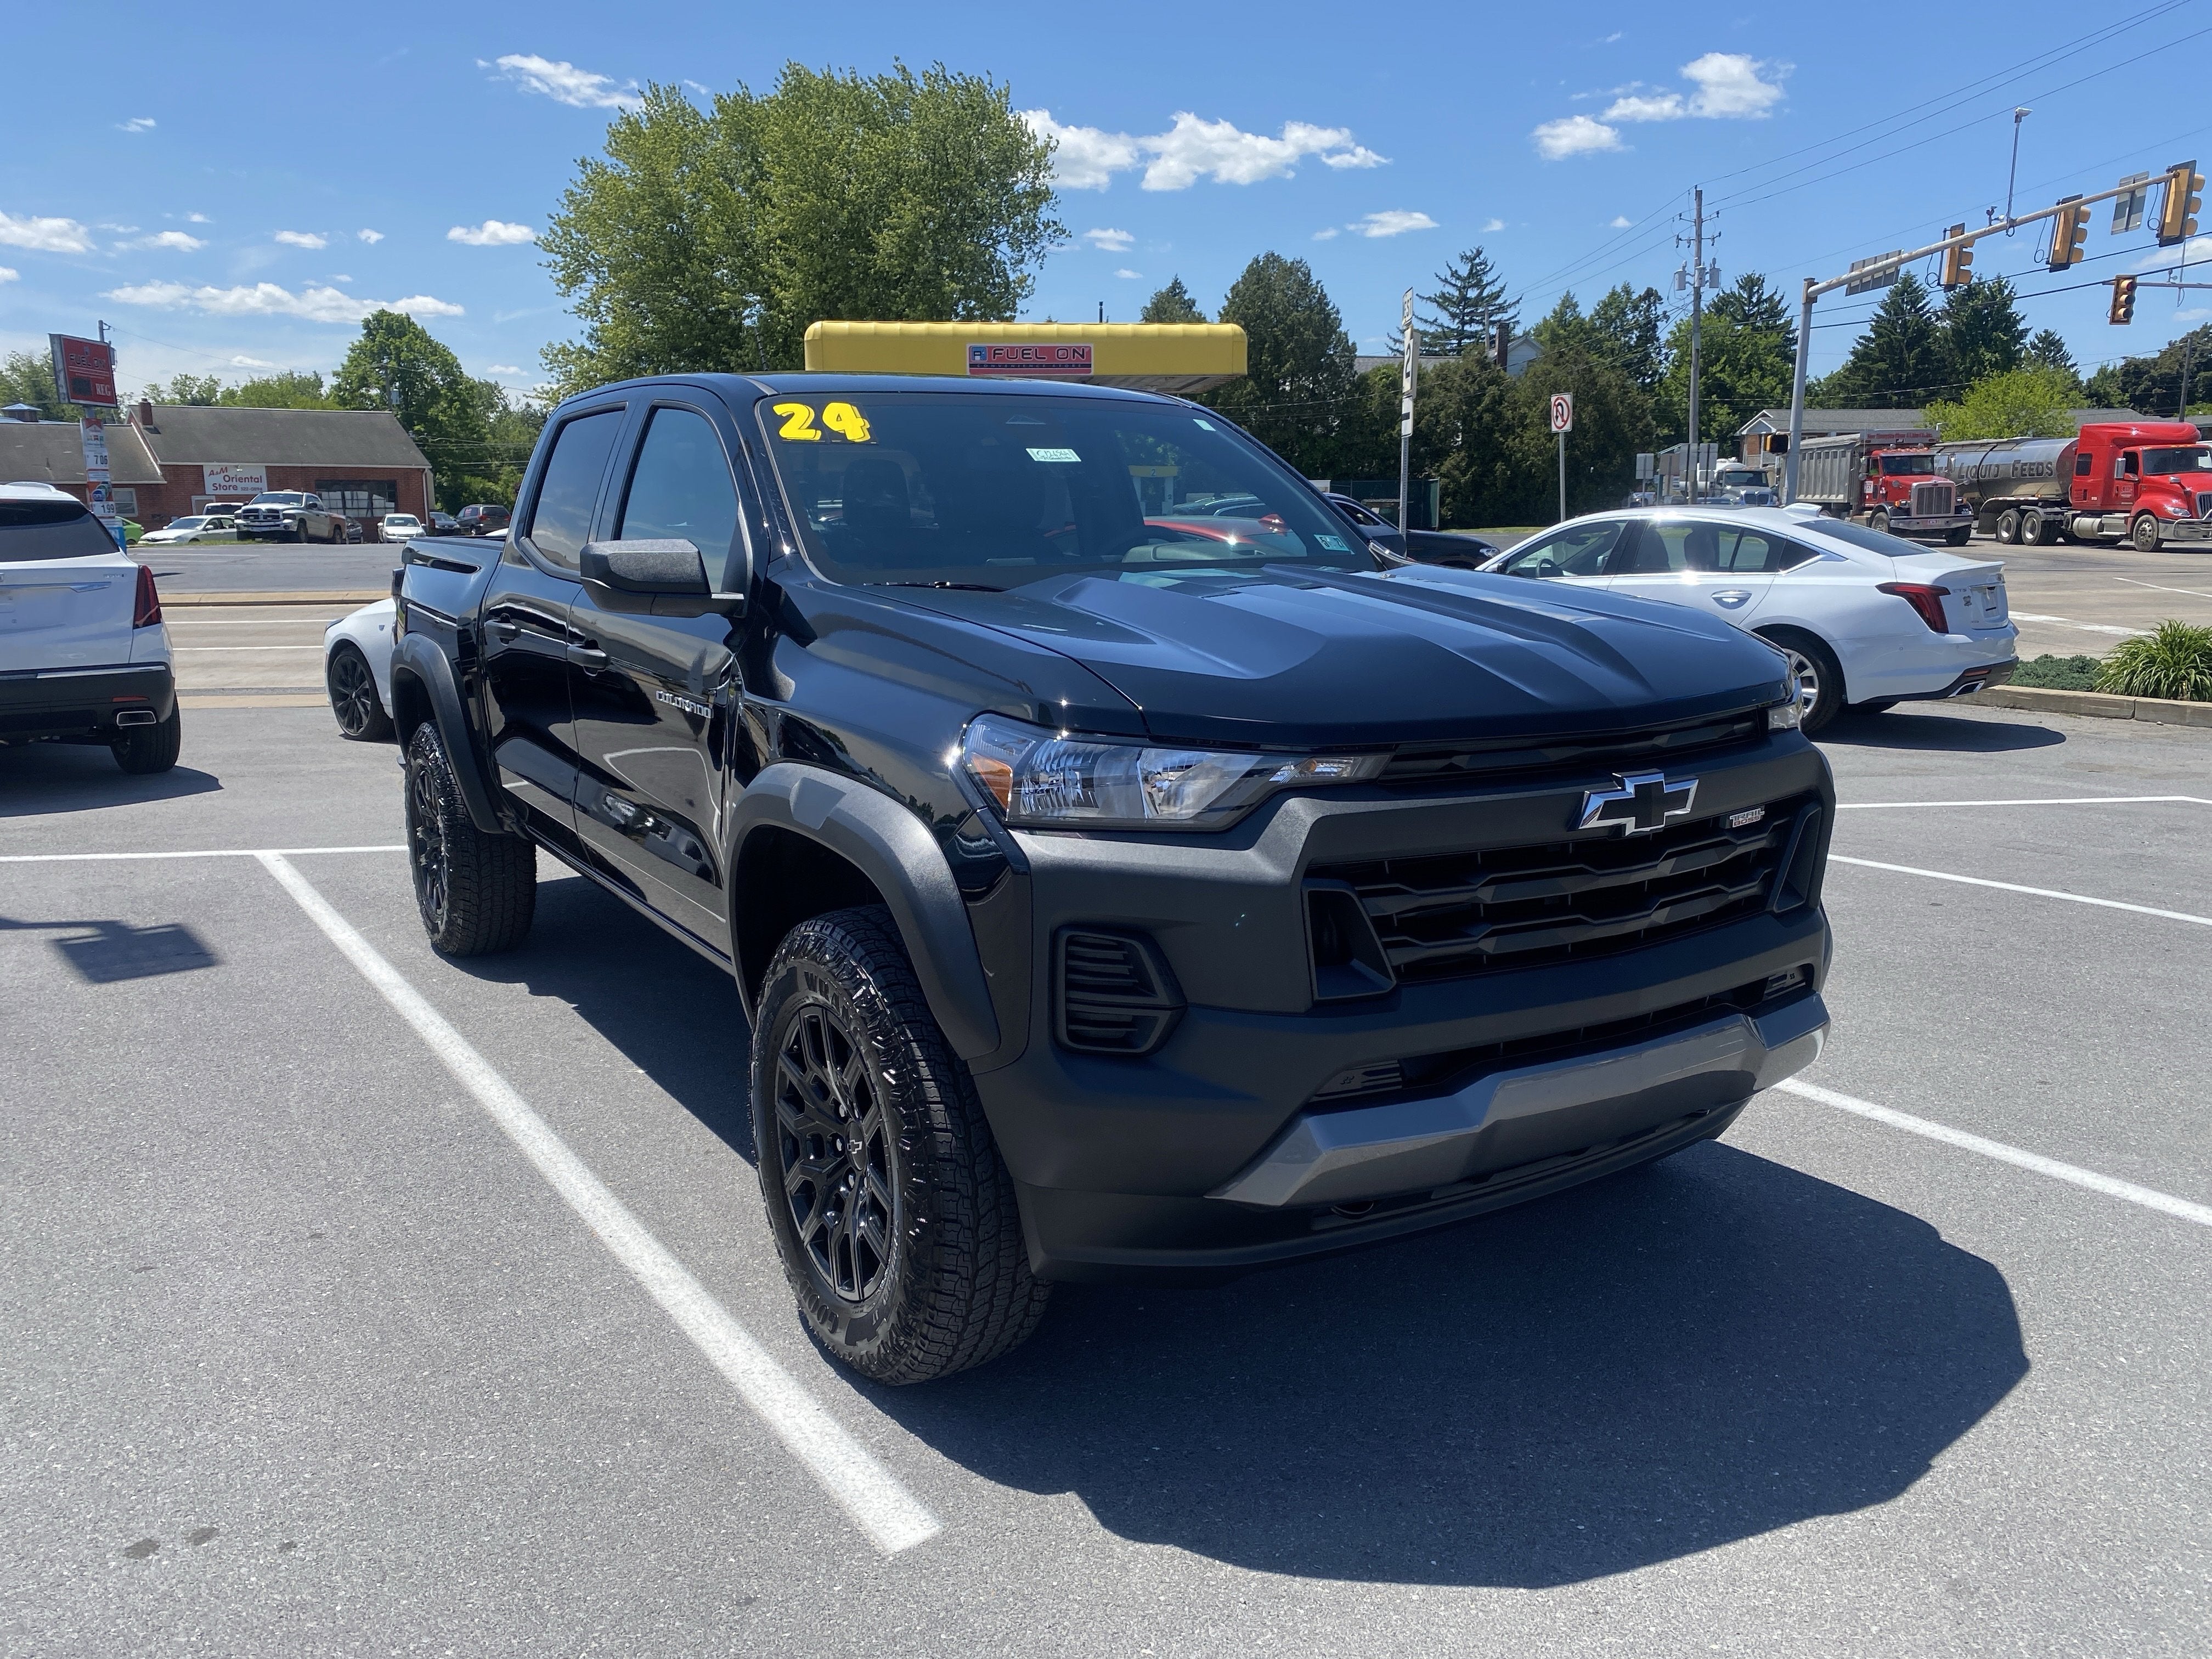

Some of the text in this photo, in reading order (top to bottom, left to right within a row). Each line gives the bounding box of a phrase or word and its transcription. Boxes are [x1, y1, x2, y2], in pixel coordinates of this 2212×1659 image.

[991, 347, 1086, 361] FUEL ON
[69, 354, 106, 369] FUEL ON
[95, 383, 111, 396] REG
[772, 402, 871, 443] 24
[208, 466, 228, 477] A&M
[1150, 469, 1156, 477] 2
[1957, 462, 2000, 480] LIQUID
[2011, 459, 2054, 479] FEEDS
[223, 475, 262, 483] Oriental
[212, 483, 238, 491] Store
[656, 691, 713, 719] COLORADO
[1729, 808, 1765, 821] TRAIL
[1733, 815, 1761, 827] BOSS
